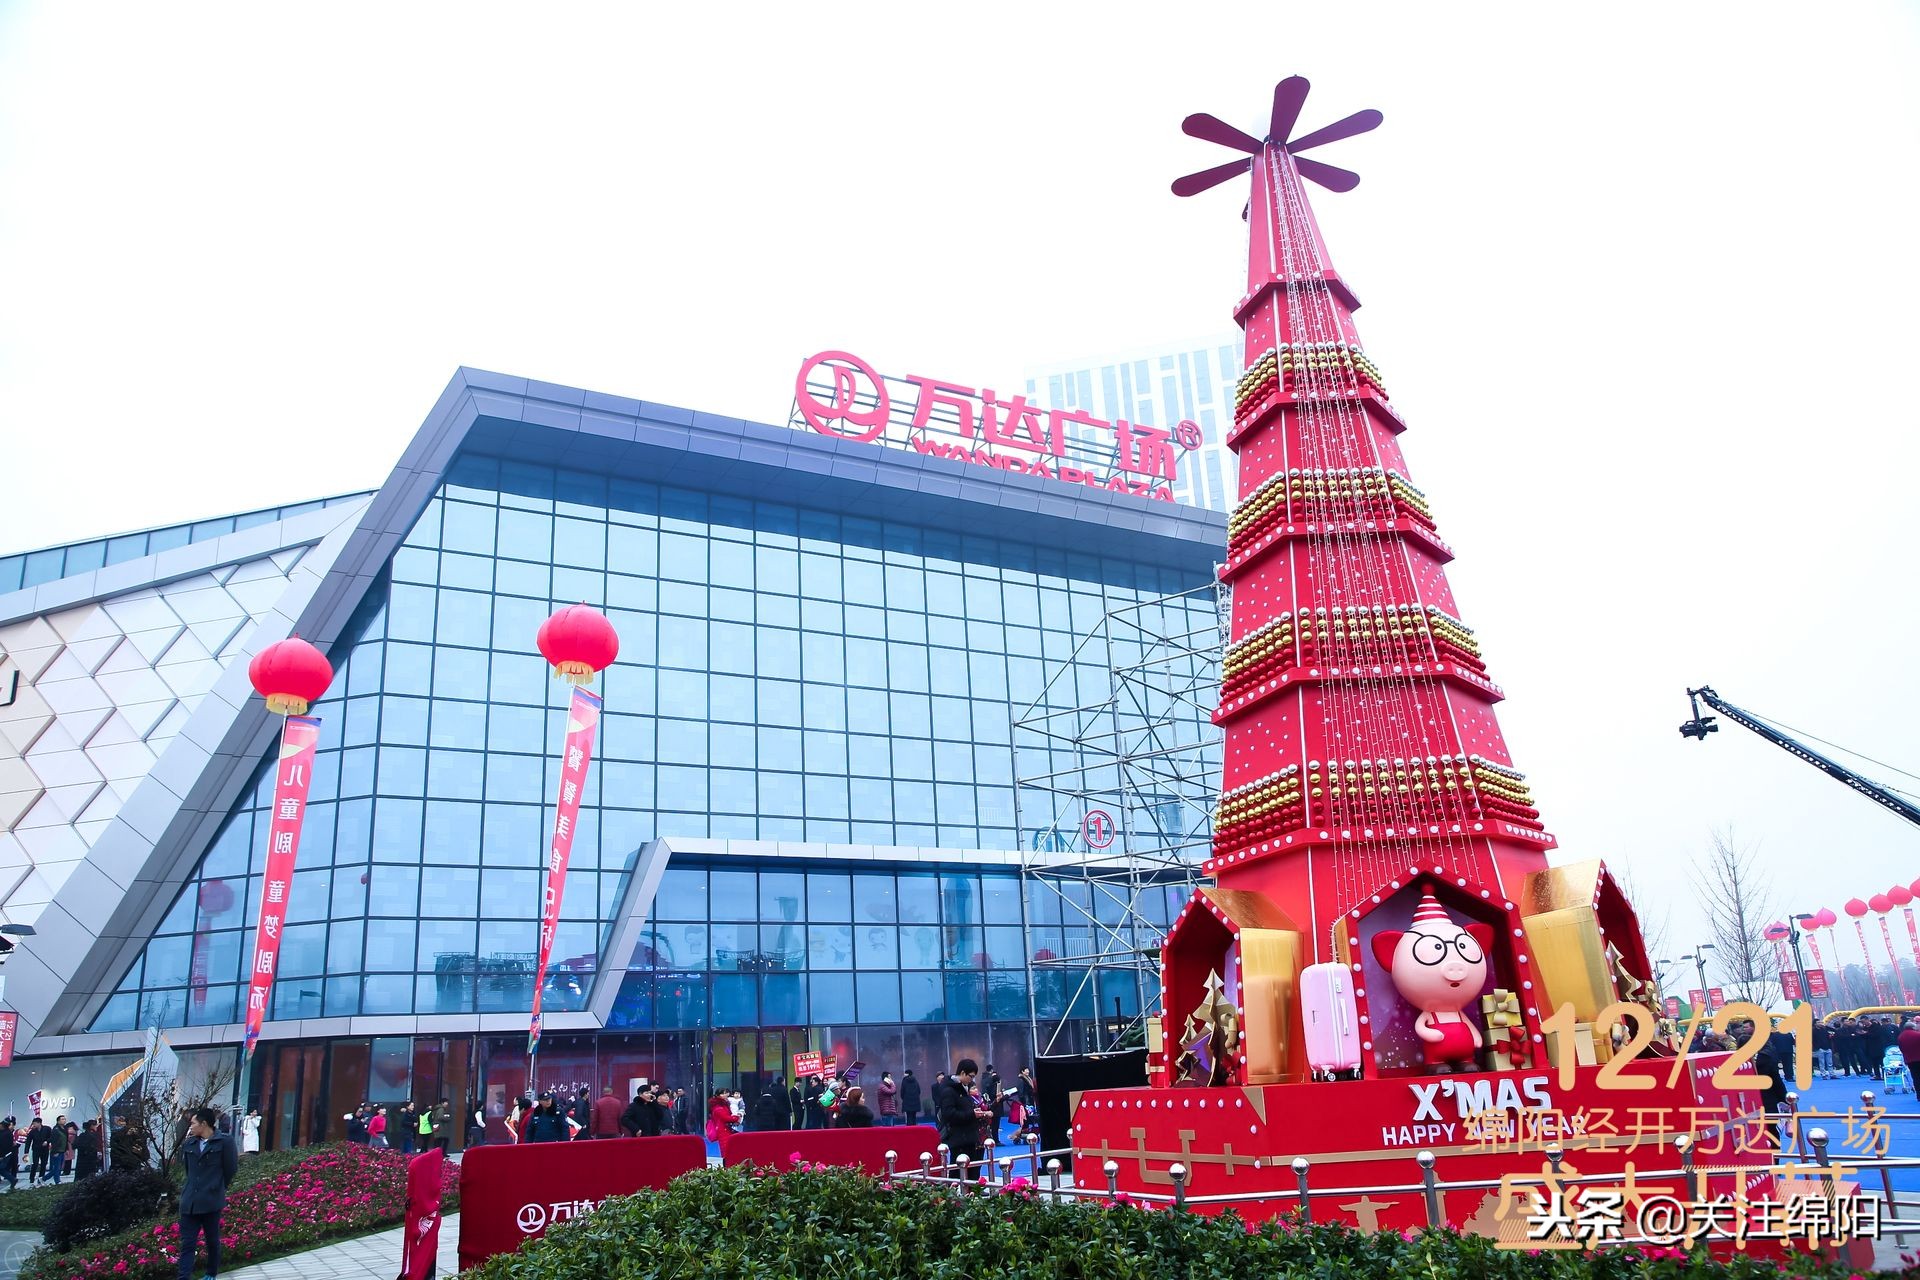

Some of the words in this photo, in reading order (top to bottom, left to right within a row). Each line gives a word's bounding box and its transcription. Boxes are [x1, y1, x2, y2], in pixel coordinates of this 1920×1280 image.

[906, 374, 1177, 480] 万达广场
[911, 436, 1054, 479] WANDA
[1059, 466, 1176, 503] PLAZA
[29, 1096, 76, 1109] owen
[1408, 1075, 1552, 1121] X'MAS
[1382, 1123, 1456, 1146] HAPPY
[1471, 1118, 1516, 1139] NEW
[1526, 1114, 1587, 1137] YEAR
